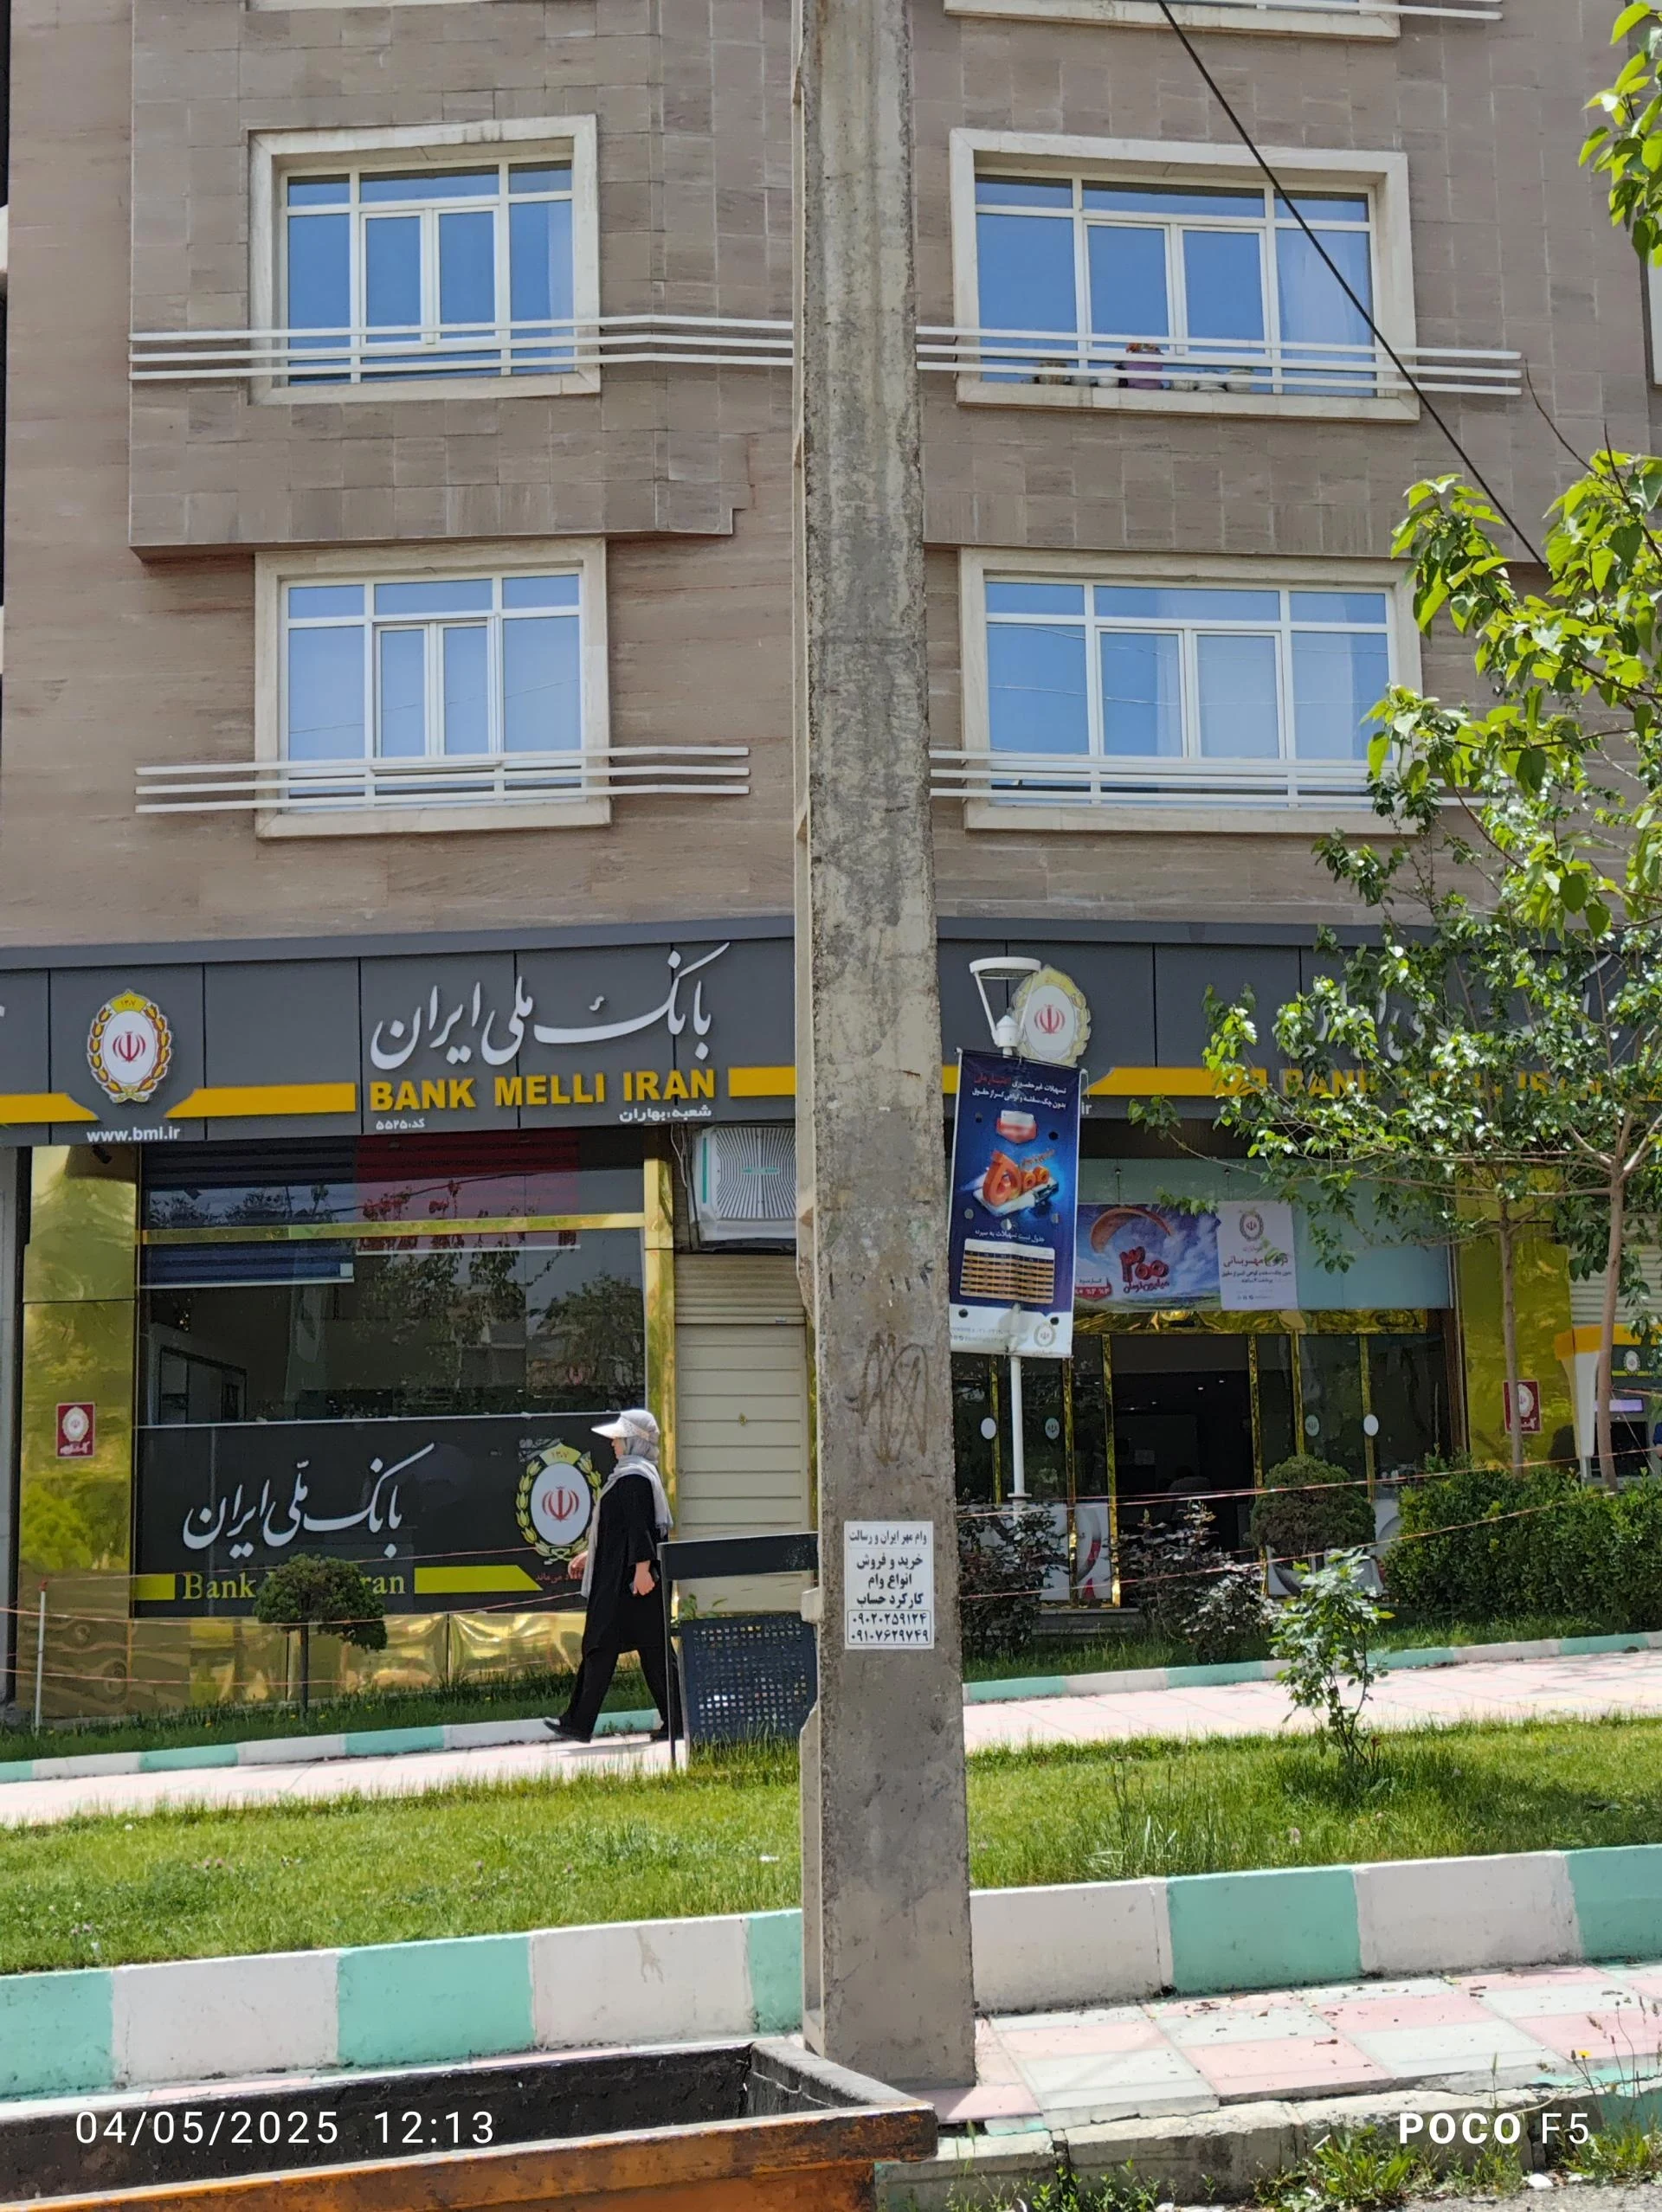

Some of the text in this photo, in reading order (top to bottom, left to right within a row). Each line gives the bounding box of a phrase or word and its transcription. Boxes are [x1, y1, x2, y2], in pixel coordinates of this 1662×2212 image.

[370, 942, 731, 1071] بانک ملی ایران
[370, 1069, 716, 1112] BANK MELLI IRAN
[87, 1126, 181, 1142] www.bml.ir
[303, 1443, 435, 1559] بانک
[183, 1479, 270, 1559] ایران
[849, 1530, 873, 1545] رسالت
[880, 1530, 899, 1545] ایران
[901, 1535, 913, 1546] مهر
[915, 1530, 927, 1545] وام
[856, 1553, 924, 1570] خرید و فروش
[183, 1572, 257, 1600] Bank
[359, 1574, 406, 1595] ran
[868, 1573, 912, 1589] انواع وام
[856, 1592, 886, 1608] حساب
